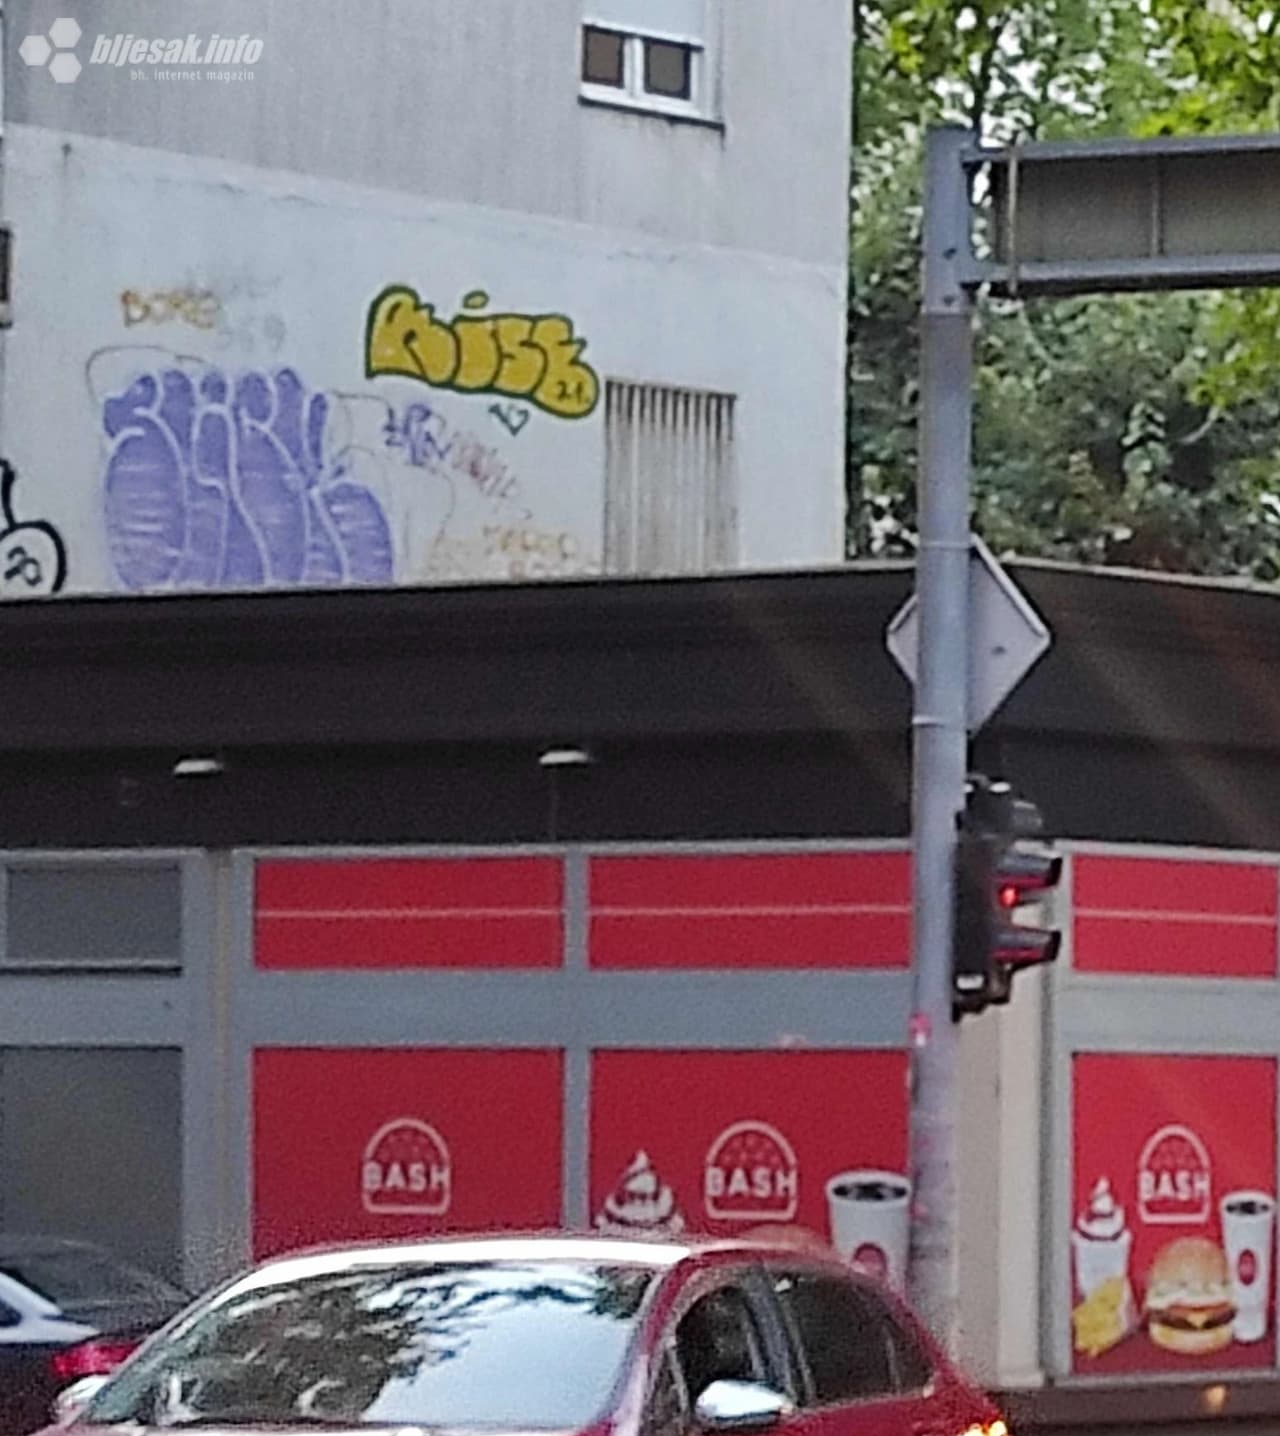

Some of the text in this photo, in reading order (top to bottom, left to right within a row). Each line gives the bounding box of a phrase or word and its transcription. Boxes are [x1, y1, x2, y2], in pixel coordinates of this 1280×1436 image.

[363, 1160, 450, 1191] BASH
[706, 1166, 797, 1197] BASH
[1140, 1170, 1210, 1200] BASH
